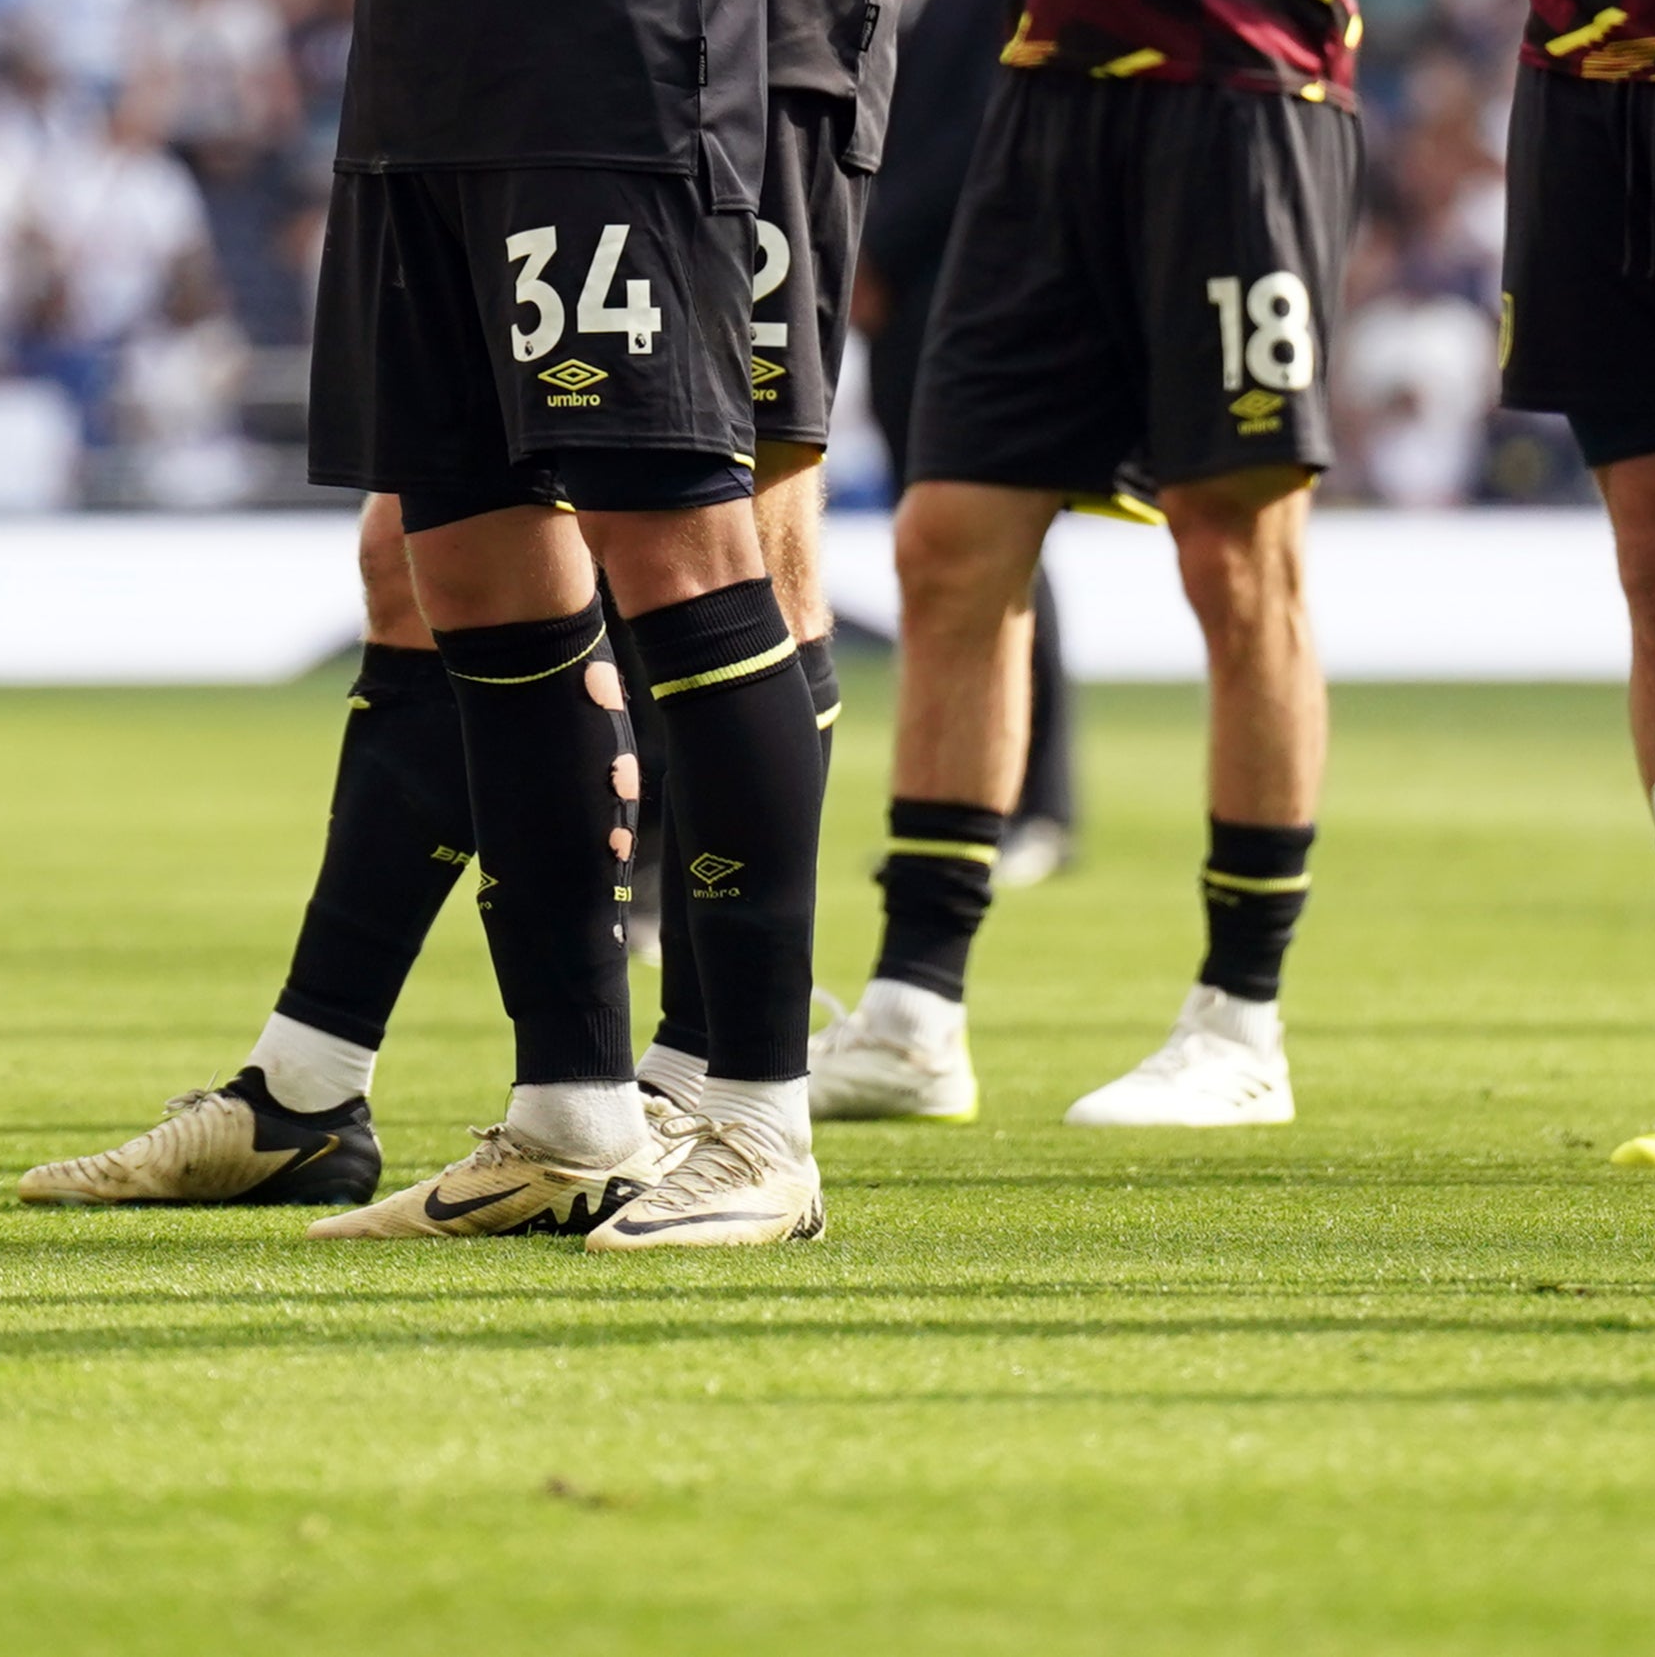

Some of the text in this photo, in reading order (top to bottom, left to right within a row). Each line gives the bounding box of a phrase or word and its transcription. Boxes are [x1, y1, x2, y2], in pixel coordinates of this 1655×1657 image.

[505, 224, 662, 363] 34
[1206, 270, 1314, 391] 18
[547, 392, 601, 407] umbro
